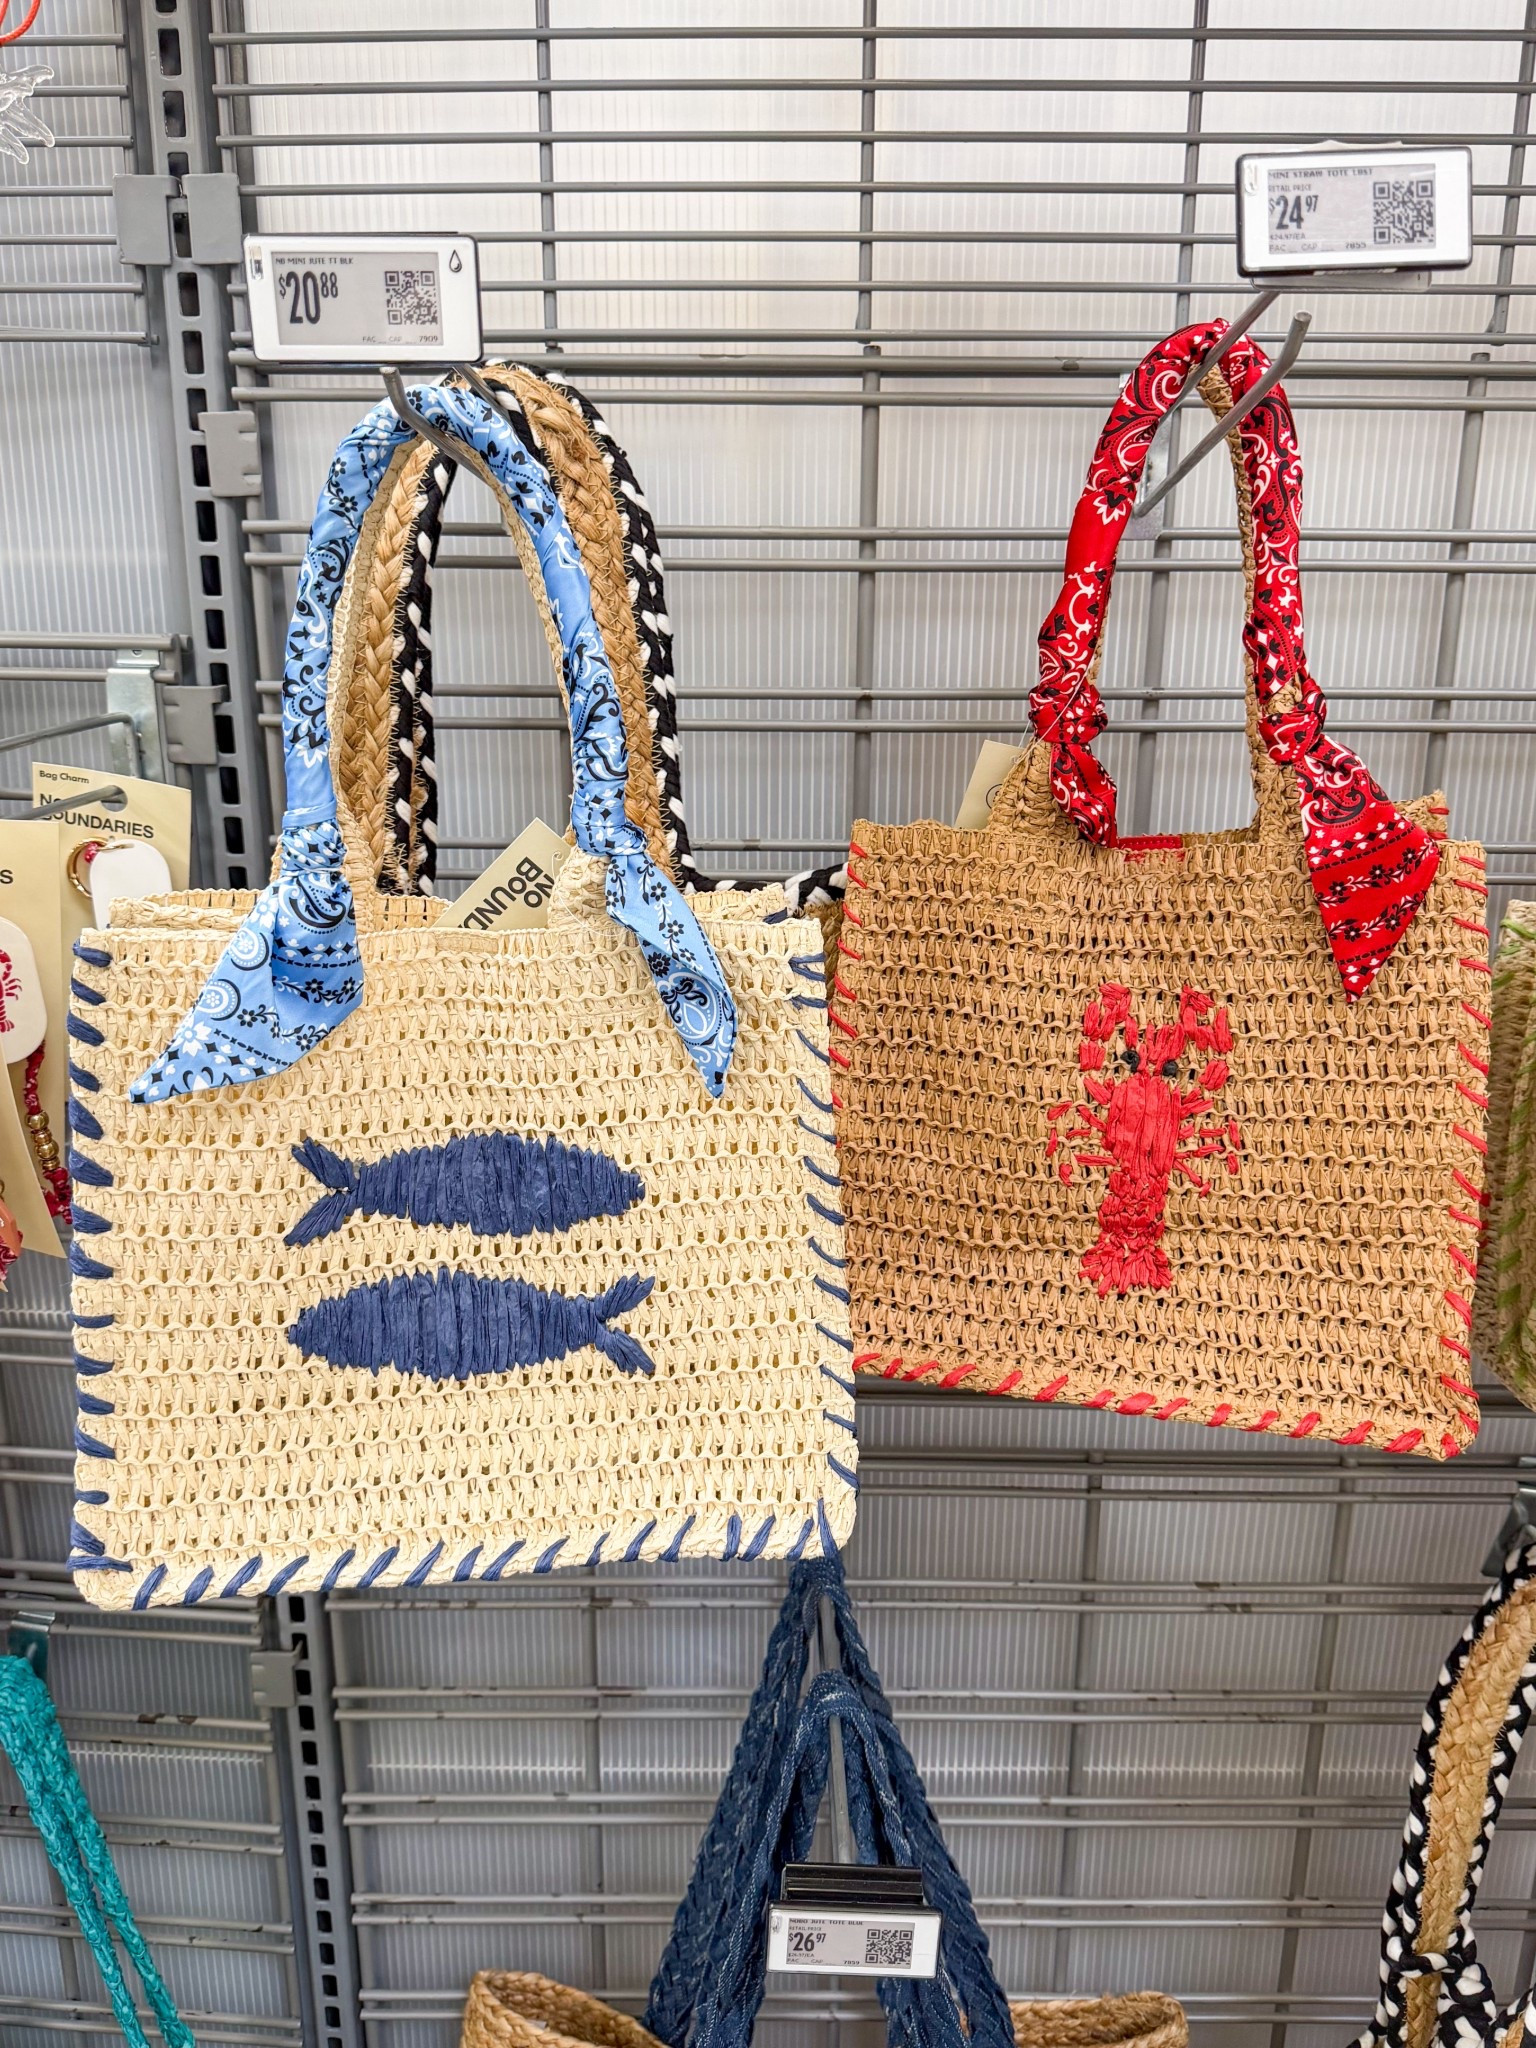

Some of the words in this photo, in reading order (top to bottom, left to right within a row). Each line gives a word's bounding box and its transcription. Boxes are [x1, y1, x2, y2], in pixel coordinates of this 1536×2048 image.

[1268, 171, 1289, 179] MINI
[1293, 170, 1323, 178] STRAW
[1327, 169, 1348, 177] TOTE
[1293, 184, 1312, 192] PRICE
[287, 257, 306, 265] MINI
[339, 257, 354, 265] BLK
[39, 770, 58, 781] Bag
[60, 772, 89, 784] Charm
[42, 810, 154, 839] UNDARIES
[457, 856, 544, 930] BOUND
